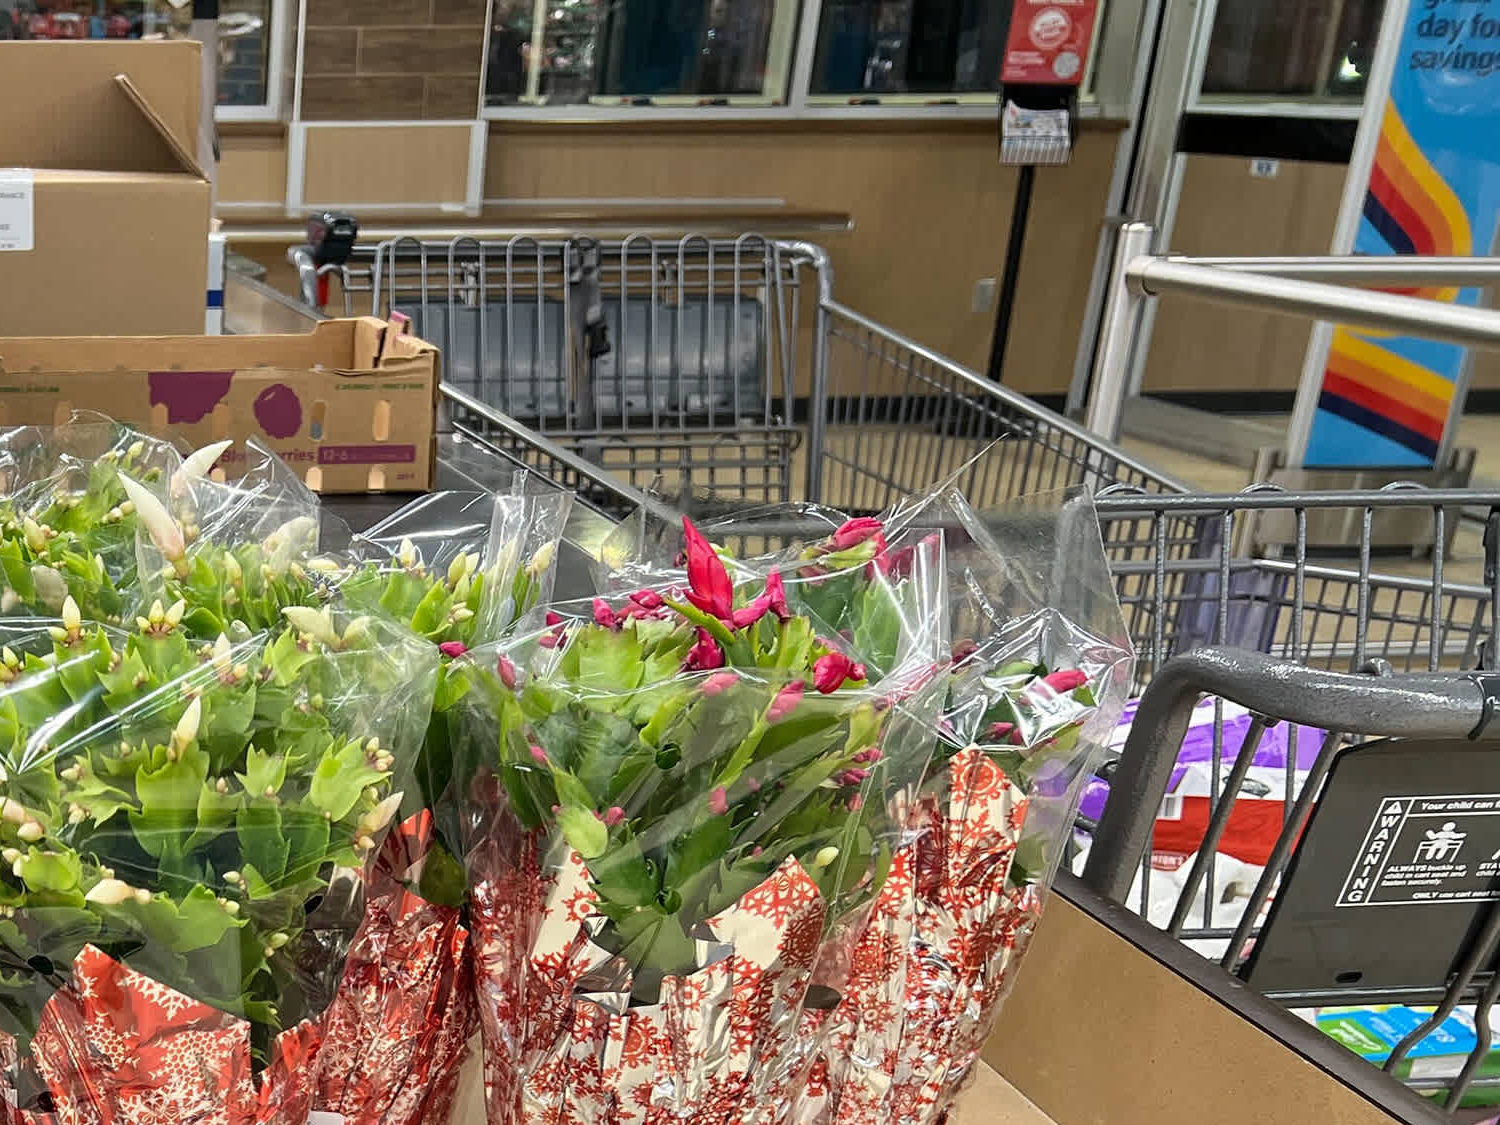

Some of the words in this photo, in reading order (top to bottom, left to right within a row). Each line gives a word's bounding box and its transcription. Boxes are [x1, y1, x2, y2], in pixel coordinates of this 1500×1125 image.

[1418, 12, 1466, 45] day
[1422, 802, 1446, 810] Your
[1447, 801, 1473, 809] child
[1348, 815, 1400, 902] WARNING
